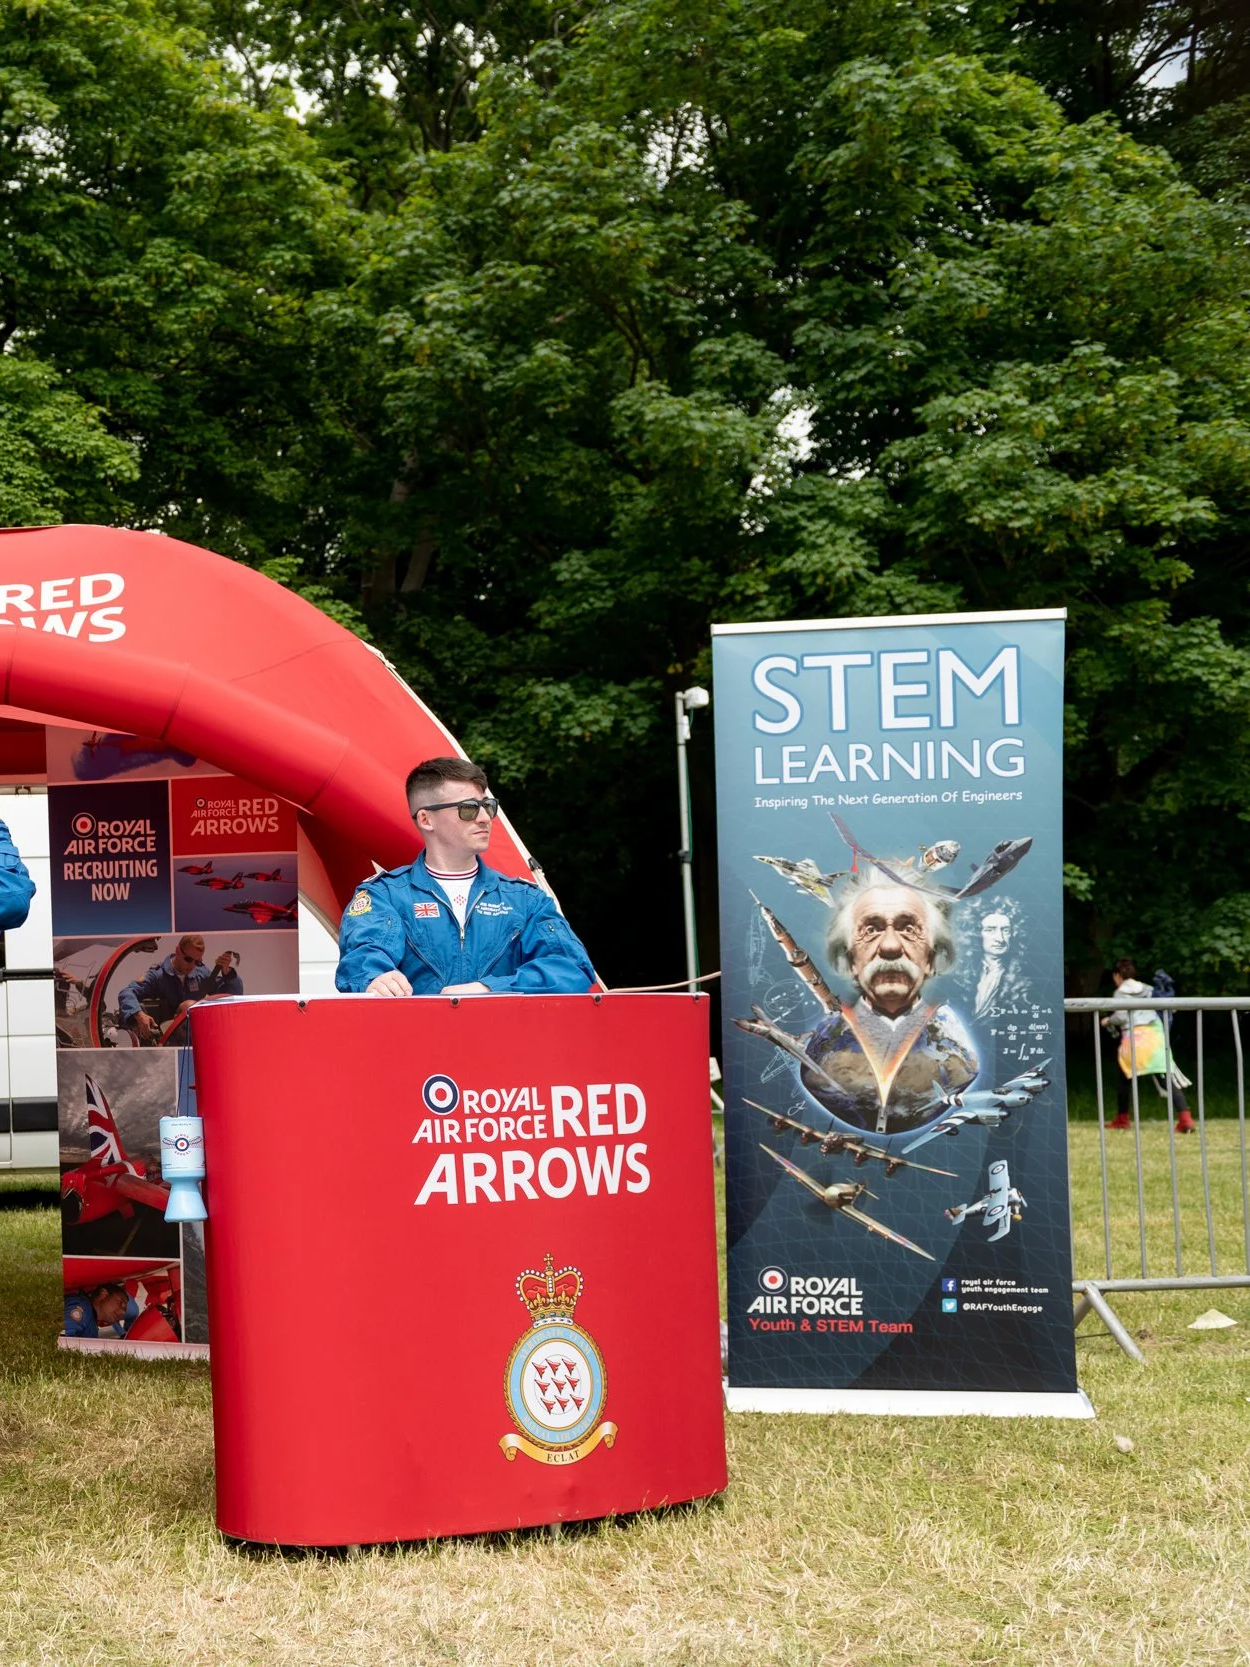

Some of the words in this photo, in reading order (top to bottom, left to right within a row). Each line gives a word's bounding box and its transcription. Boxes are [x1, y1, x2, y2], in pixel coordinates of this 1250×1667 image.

[753, 646, 1021, 734] STEM
[754, 737, 1026, 785] LEARNING
[207, 799, 236, 809] ROYAL
[238, 798, 279, 816] RED
[754, 798, 808, 810] Inspiring
[812, 795, 835, 806] The
[838, 794, 869, 805] Next
[872, 793, 938, 804] Generation
[941, 792, 958, 802] Of
[962, 790, 1023, 804] Engineers
[190, 808, 206, 818] AIR
[207, 808, 237, 817] FORCE
[98, 818, 156, 836] ROYAL
[190, 816, 279, 836] ARROWS
[64, 838, 96, 856] AIR
[98, 836, 156, 854] FORCE
[64, 859, 158, 880] RECRUITING
[91, 882, 130, 902] NOW
[462, 1086, 546, 1114] ROYAL
[550, 1082, 648, 1138] RED
[412, 1118, 462, 1144] AIR
[466, 1114, 548, 1143] FORCE
[414, 1142, 650, 1206] ARROWS
[790, 1276, 863, 1296] ROYAL
[961, 1278, 980, 1286] royal
[996, 1278, 1016, 1286] force
[961, 1286, 982, 1294] youth
[746, 1296, 788, 1314] AIR
[790, 1296, 863, 1315] FORCE
[962, 1303, 1043, 1314] @RAFYouthEngage
[749, 1318, 795, 1331] Youth
[800, 1319, 812, 1331] &
[816, 1320, 864, 1333] STEM
[868, 1320, 913, 1333] Team
[546, 1450, 580, 1462] ECLAT
